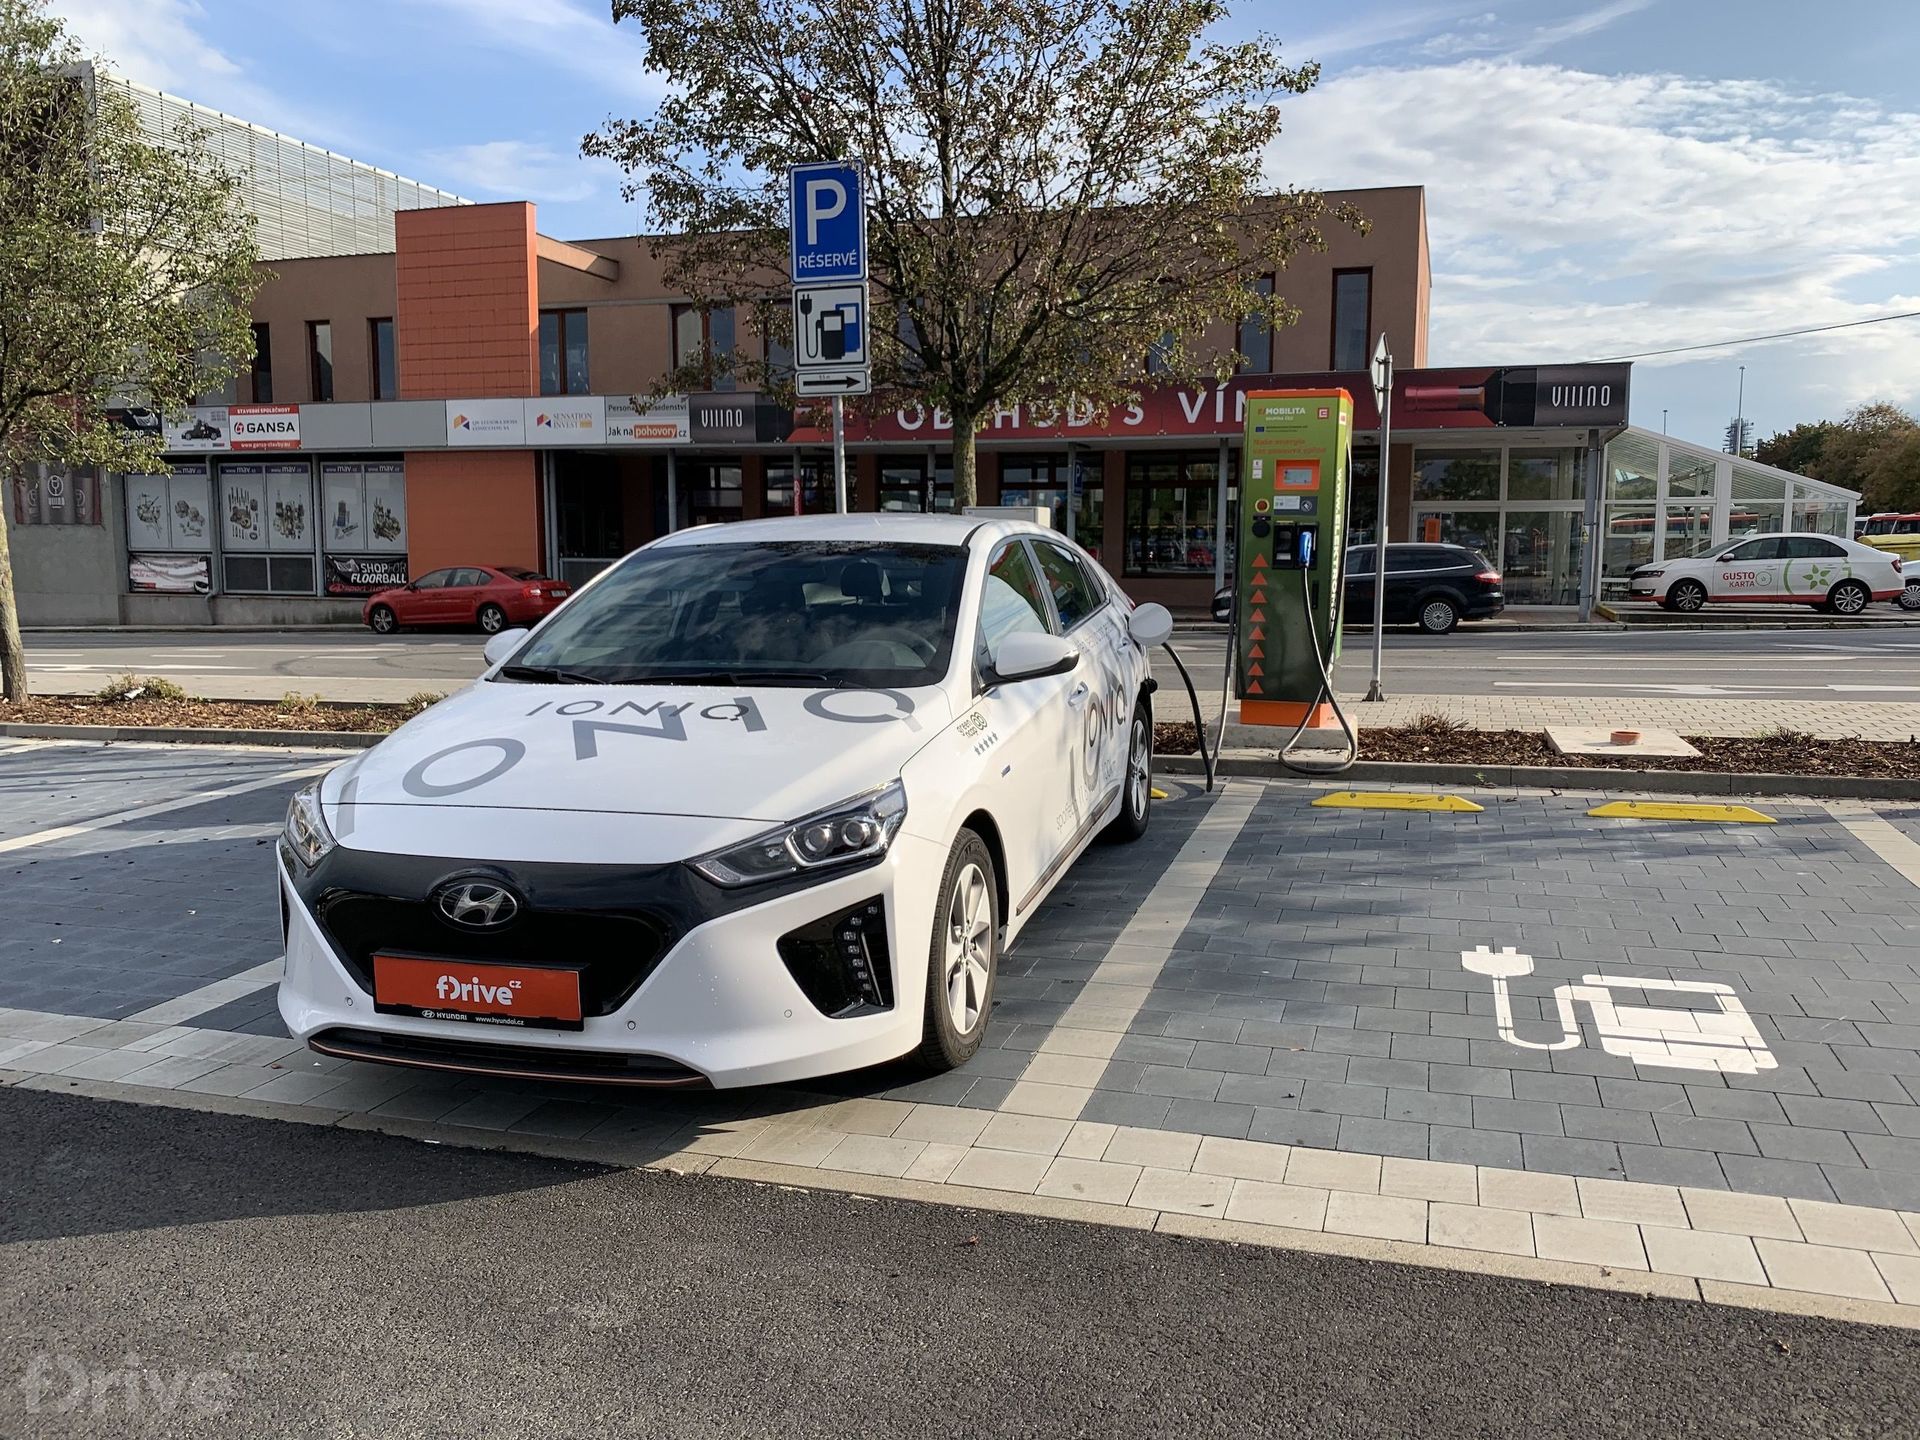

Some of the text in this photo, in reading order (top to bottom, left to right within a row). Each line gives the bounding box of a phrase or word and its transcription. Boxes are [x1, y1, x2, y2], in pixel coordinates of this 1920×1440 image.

[806, 179, 847, 246] P
[799, 249, 857, 269] RÉSERVÉ
[896, 399, 1095, 431] OBHOD
[246, 422, 295, 433] GANSA
[608, 426, 621, 436] Jak
[623, 428, 633, 436] na
[635, 426, 676, 438] pohovory
[351, 573, 407, 584] FLOORBALL
[1722, 571, 1755, 581] GUSTO
[526, 699, 749, 721] IONIQ
[436, 974, 513, 1006] fDrive
[436, 1012, 524, 1026] HYUNDAI www.hyundai.cz
